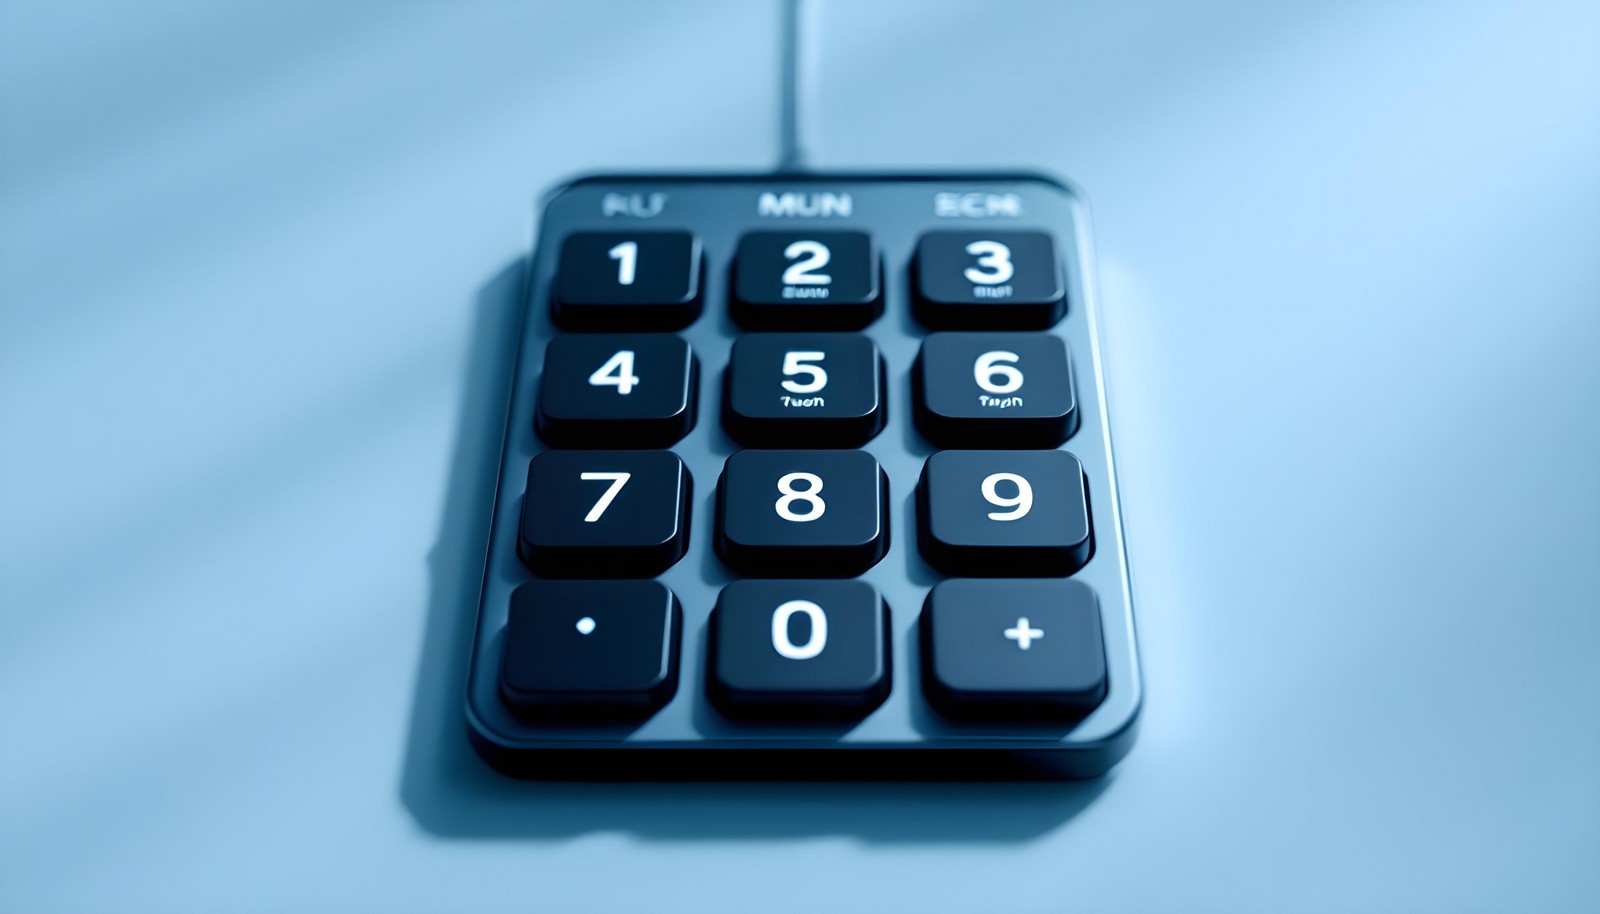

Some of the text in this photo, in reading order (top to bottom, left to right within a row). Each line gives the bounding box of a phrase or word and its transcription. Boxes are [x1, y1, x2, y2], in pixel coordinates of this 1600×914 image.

[759, 192, 852, 217] MUN
[609, 242, 637, 285] 1
[782, 240, 832, 285] 2
[964, 240, 1014, 285] 3
[588, 350, 640, 395] 4
[781, 351, 828, 394] 5
[973, 351, 1025, 395] 6
[580, 473, 631, 523] 7
[775, 472, 826, 523] 8
[980, 472, 1034, 522] 9
[771, 600, 828, 660] 0
[1003, 616, 1045, 651] +
